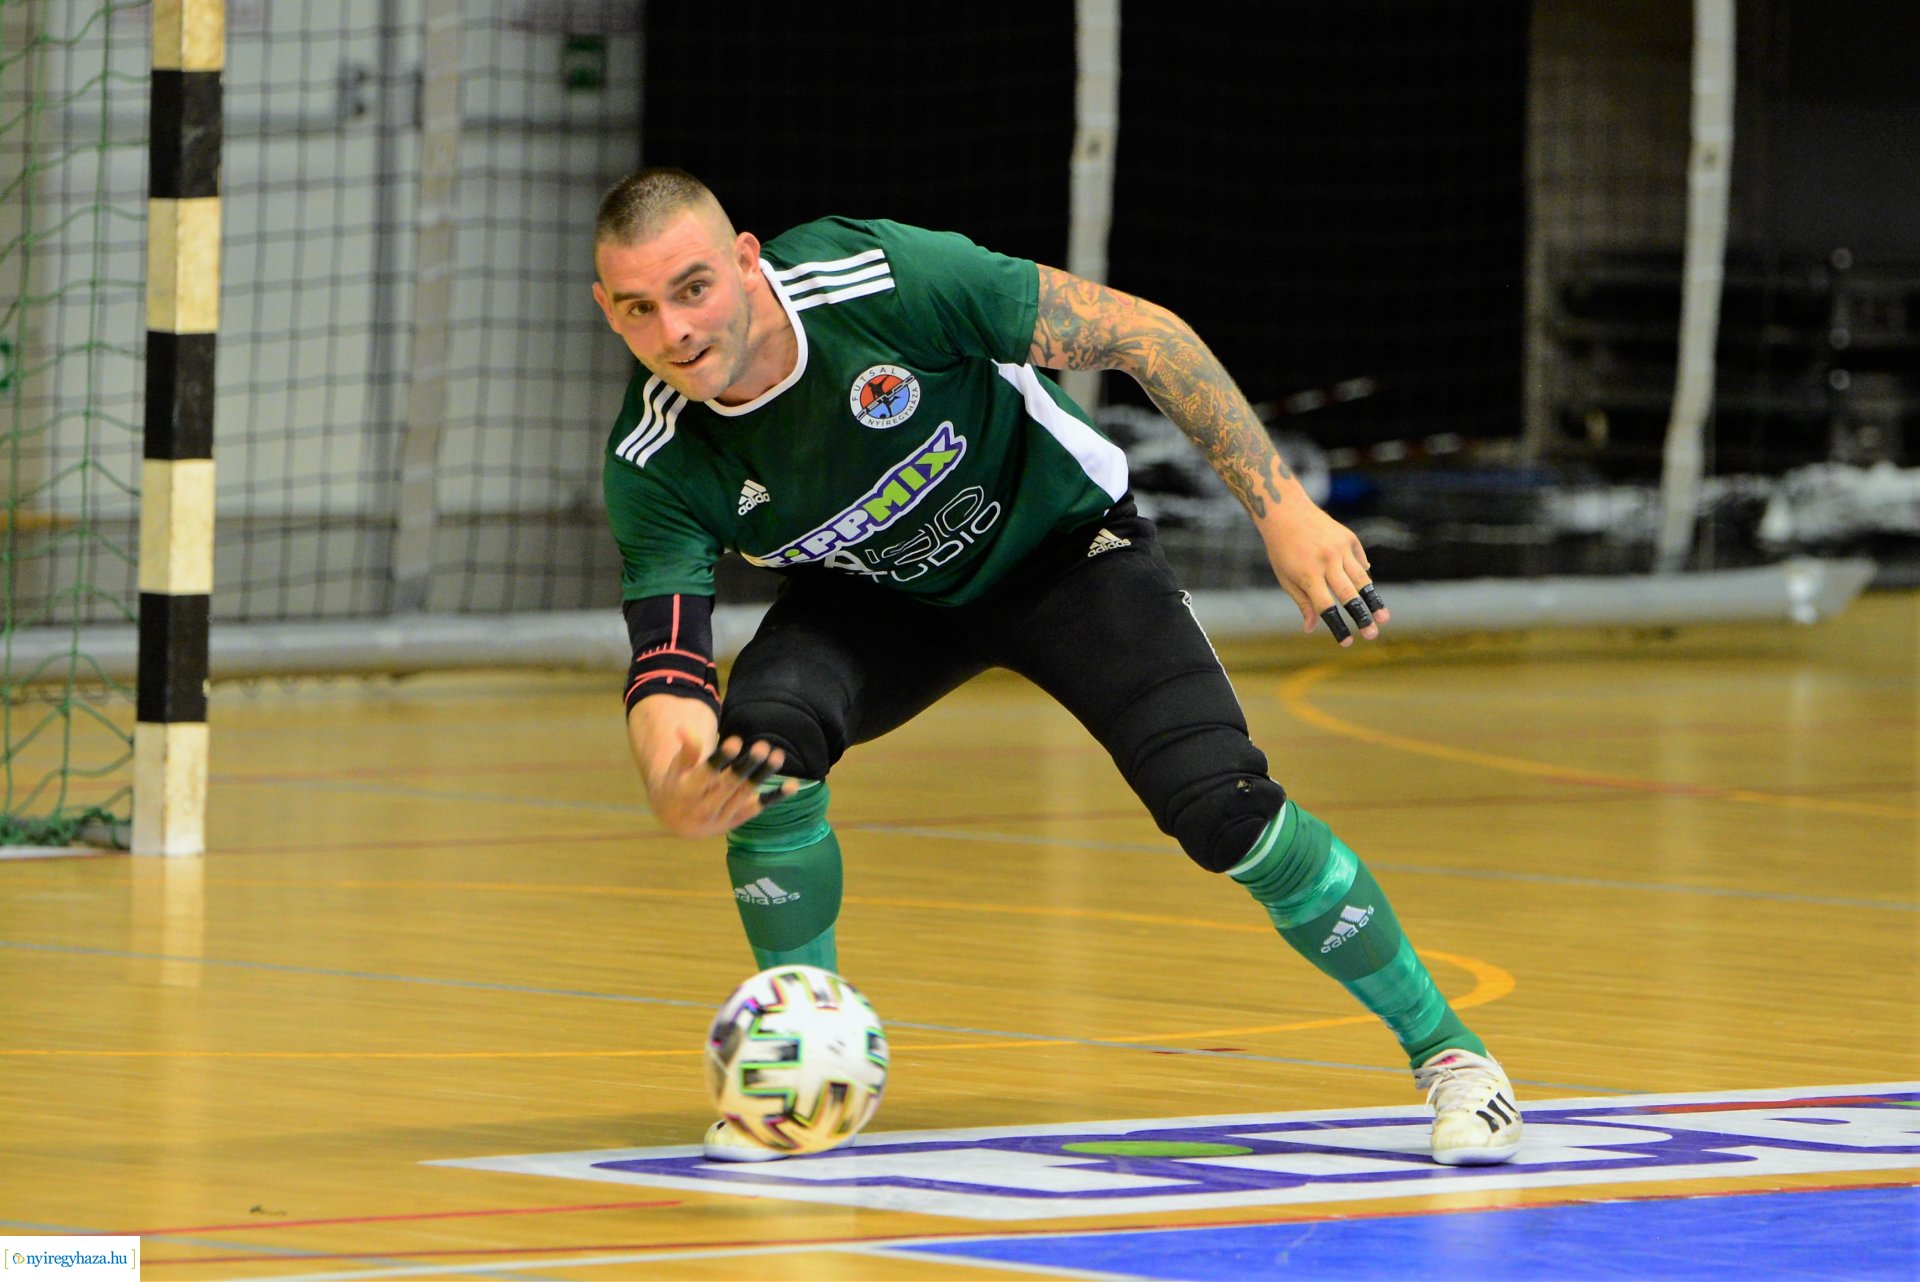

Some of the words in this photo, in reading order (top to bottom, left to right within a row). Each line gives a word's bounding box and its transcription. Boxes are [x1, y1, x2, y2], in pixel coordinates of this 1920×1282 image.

[852, 367, 896, 401] FUTSAL
[738, 492, 771, 516] adida
[1088, 538, 1132, 557] adidas
